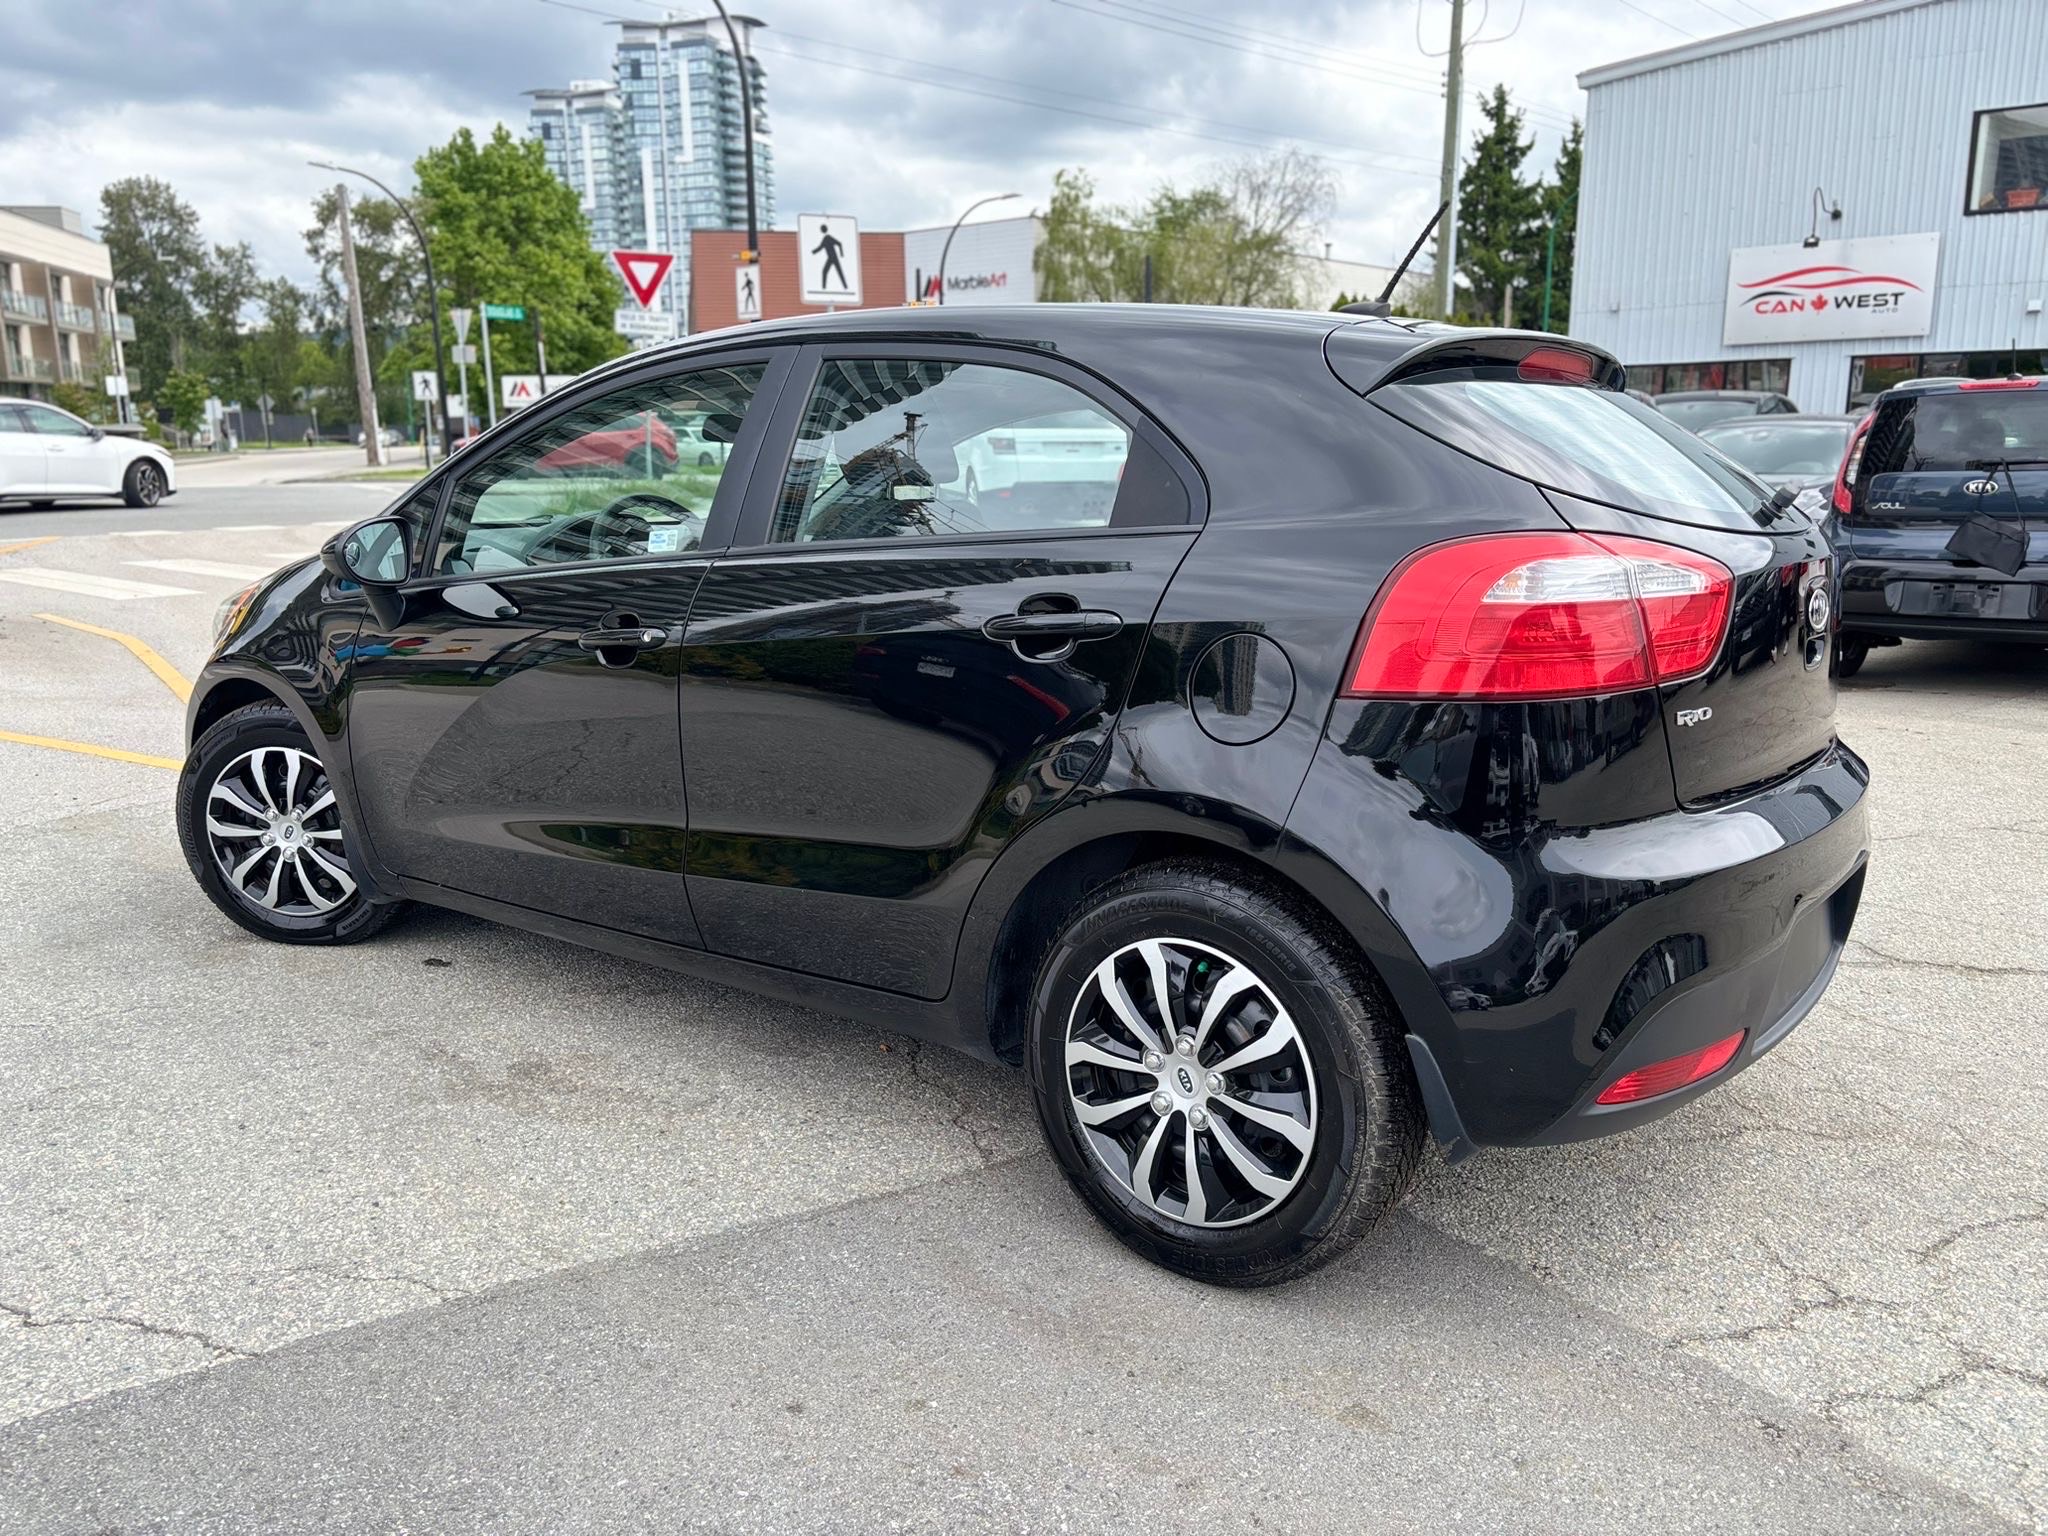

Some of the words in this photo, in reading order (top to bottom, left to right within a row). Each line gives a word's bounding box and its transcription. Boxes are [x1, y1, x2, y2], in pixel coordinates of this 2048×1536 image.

[947, 272, 1007, 290] MarbleArt
[1754, 298, 1806, 314] CAN
[1833, 291, 1905, 309] WEST
[1179, 1069, 1192, 1091] KIA
